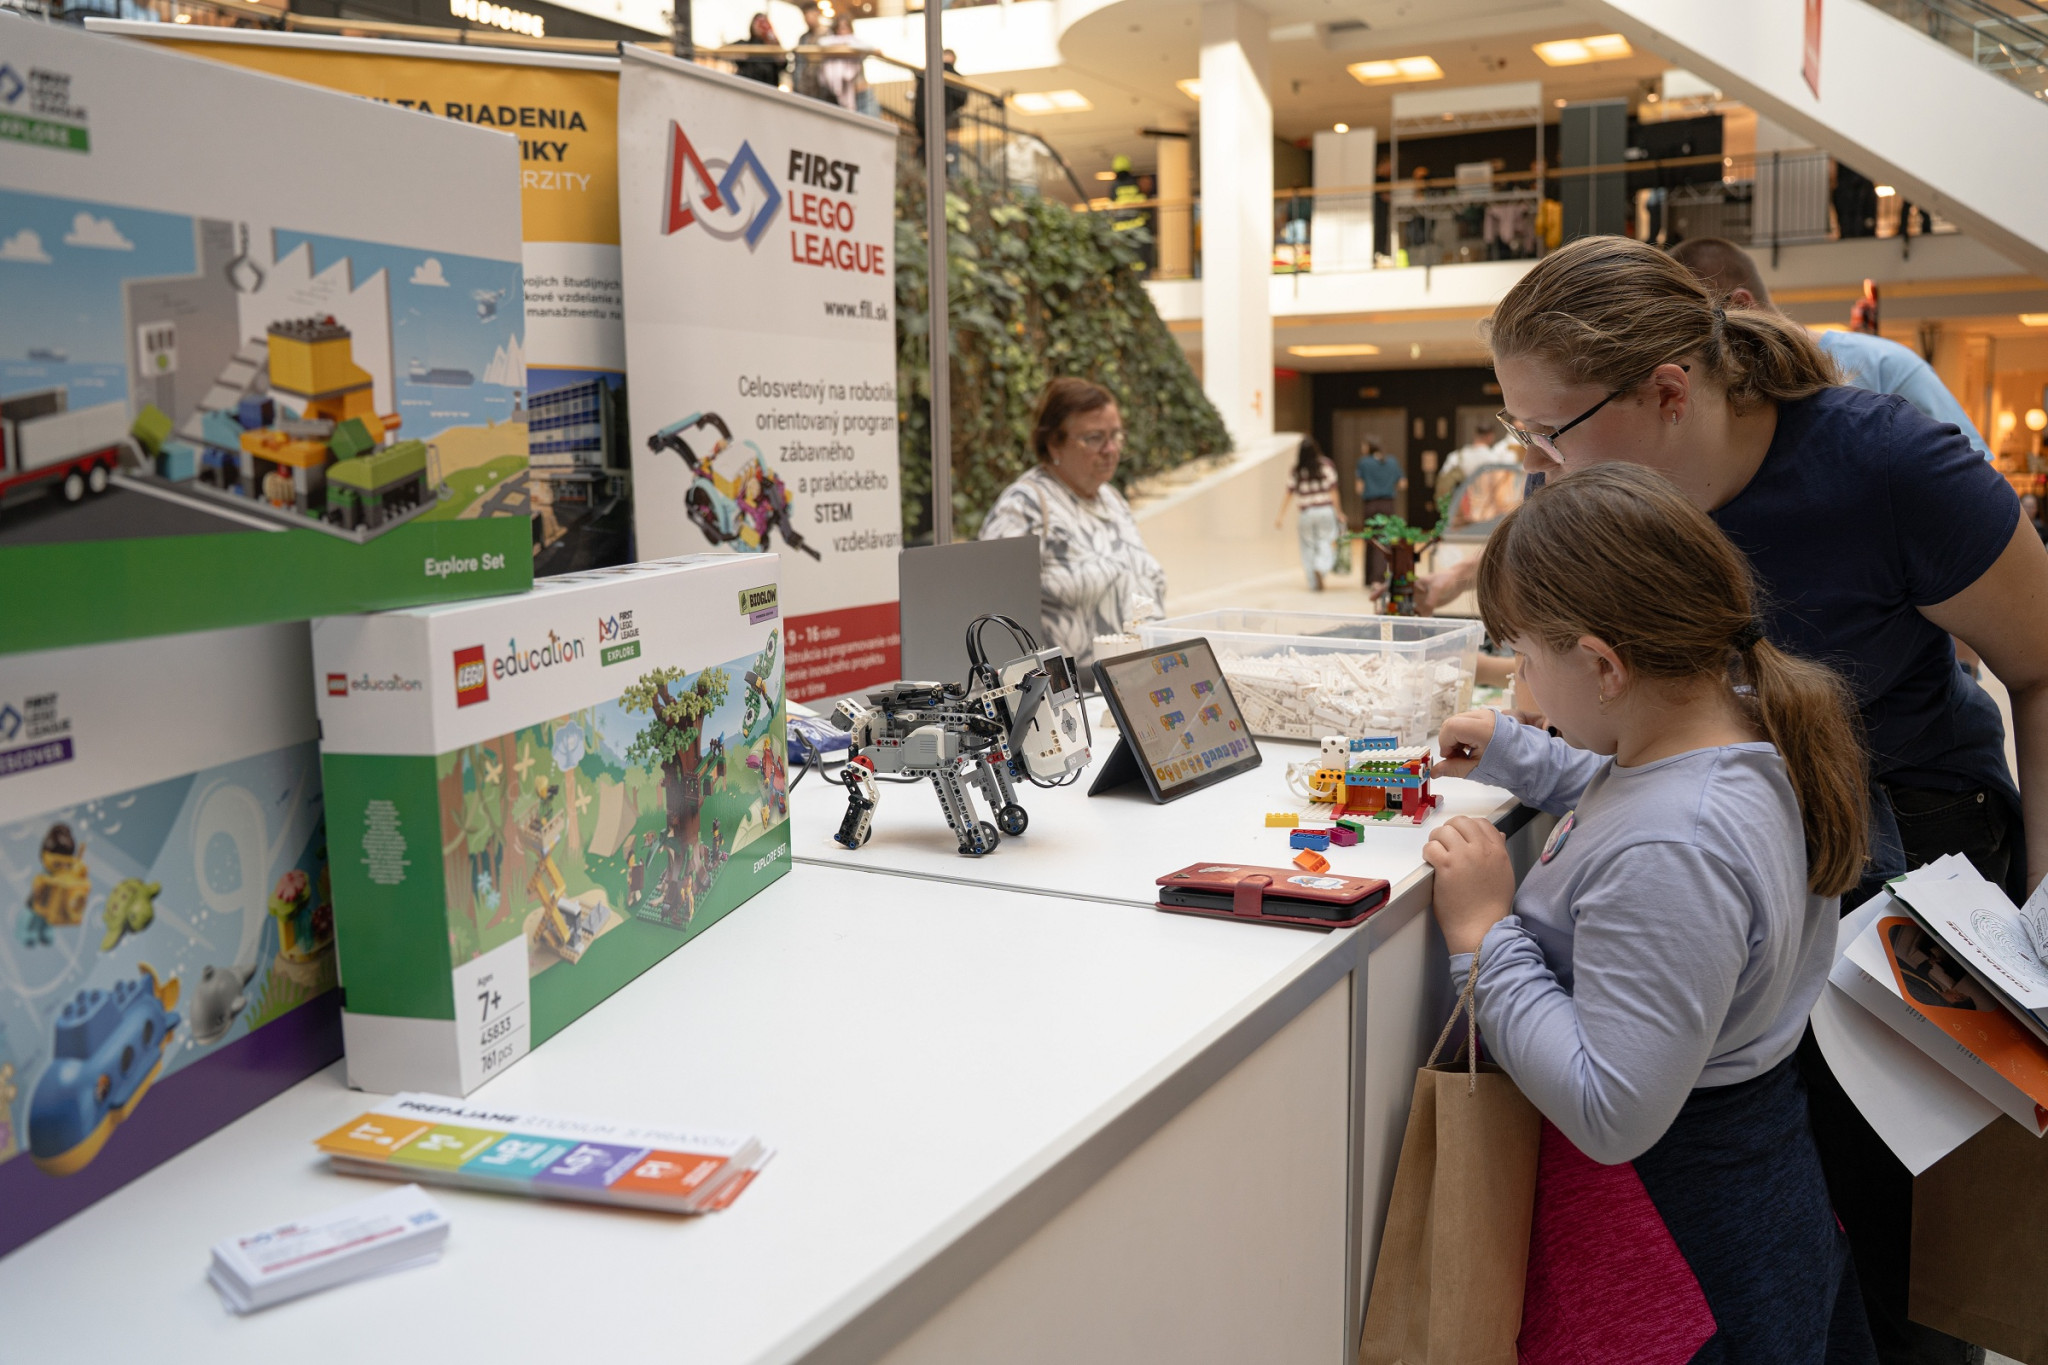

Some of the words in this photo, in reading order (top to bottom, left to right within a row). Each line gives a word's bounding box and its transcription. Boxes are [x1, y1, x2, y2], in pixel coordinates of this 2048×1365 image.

[445, 102, 588, 132] RIADENIA
[0, 118, 70, 145] XPLORE
[788, 149, 860, 194] FIRST
[788, 189, 855, 232] LEGO
[791, 230, 885, 276] LEAGUE
[824, 300, 888, 321] www.fll.sk
[738, 375, 826, 405] Celosvetový
[828, 385, 846, 400] na
[756, 408, 839, 436] orientovaný
[780, 441, 855, 463] zábavného
[798, 477, 807, 494] a
[810, 470, 889, 498] praktického
[815, 503, 853, 524] STEM
[425, 555, 478, 579] Explore
[482, 553, 505, 570] Set
[750, 588, 776, 607] BIOGLOW
[619, 610, 633, 620] FIRST
[620, 620, 633, 630] LEGO
[621, 628, 640, 640] LEAGUE
[787, 629, 797, 646] 9
[805, 625, 820, 642] 16
[458, 661, 485, 690] LEGO
[493, 628, 585, 680] education
[607, 645, 635, 662] EXPLORE
[351, 673, 422, 692] education
[0, 743, 64, 774] ISCOVER
[753, 849, 777, 874] EXPLORE
[777, 842, 787, 857] SET
[477, 990, 502, 1022] 7+
[481, 1016, 512, 1046] 45833
[482, 1050, 497, 1074] 761
[498, 1043, 513, 1068] pcs
